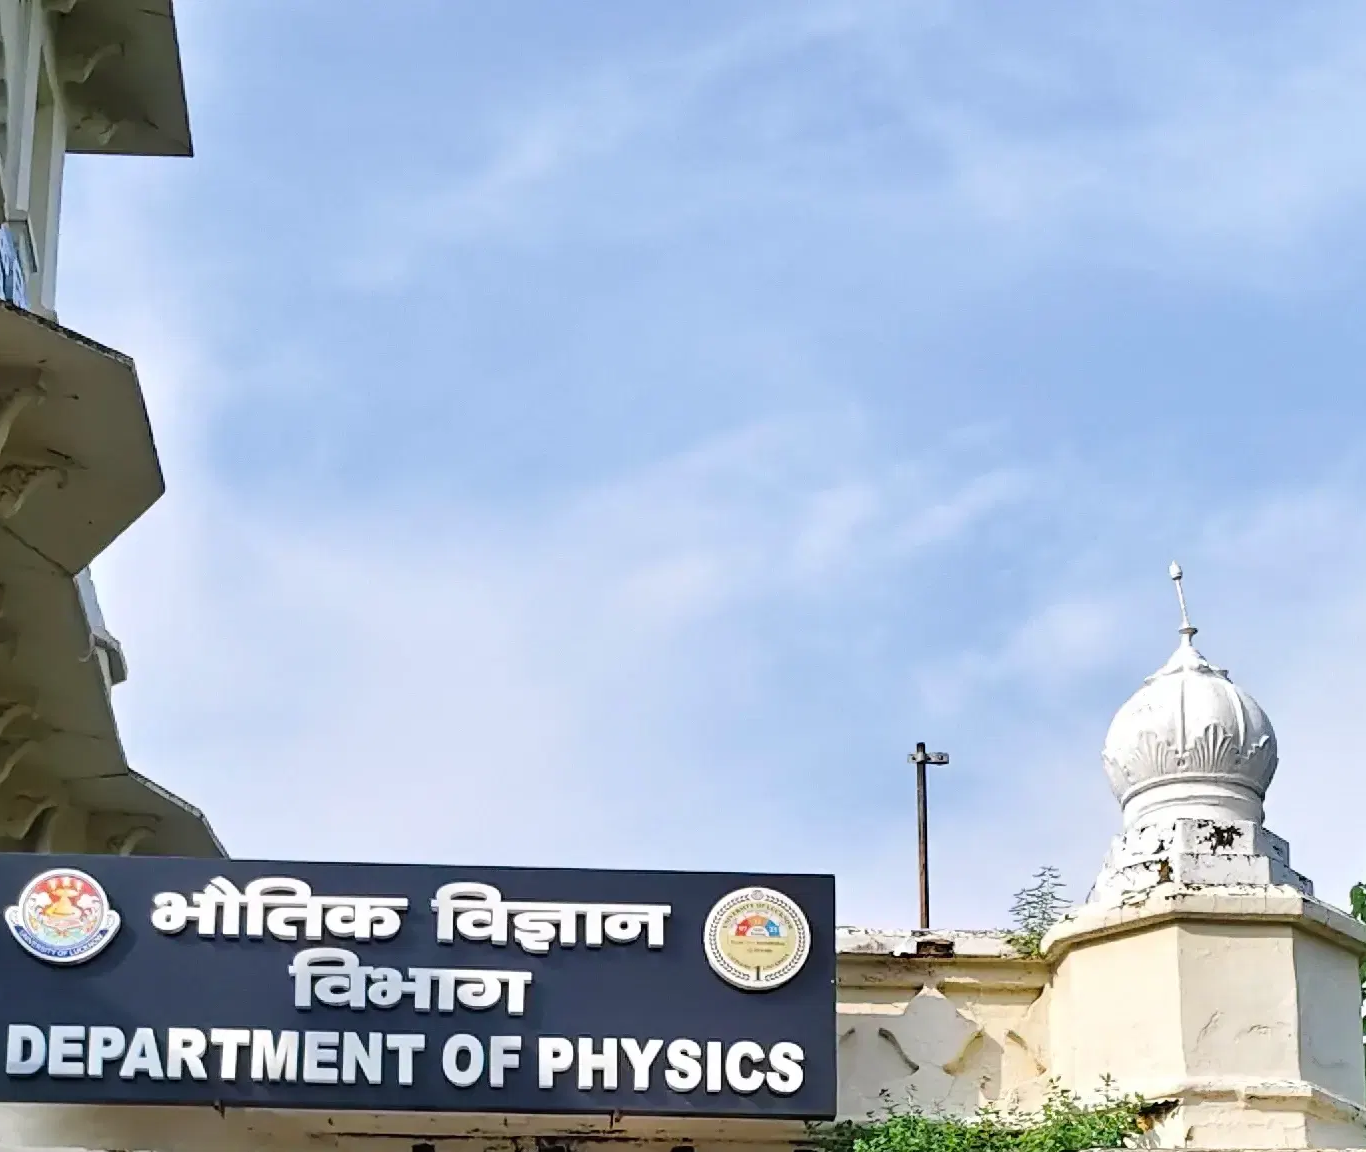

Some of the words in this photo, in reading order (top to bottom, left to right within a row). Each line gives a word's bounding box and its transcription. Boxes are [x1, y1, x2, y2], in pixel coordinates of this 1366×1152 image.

[151, 876, 408, 941] भौतिक
[431, 882, 671, 955] विज्ञान
[289, 948, 532, 1016] विभाग
[6, 1024, 426, 1087] DEPARTMENT
[442, 1033, 522, 1088] OF
[538, 1037, 805, 1094] PHYSICS
